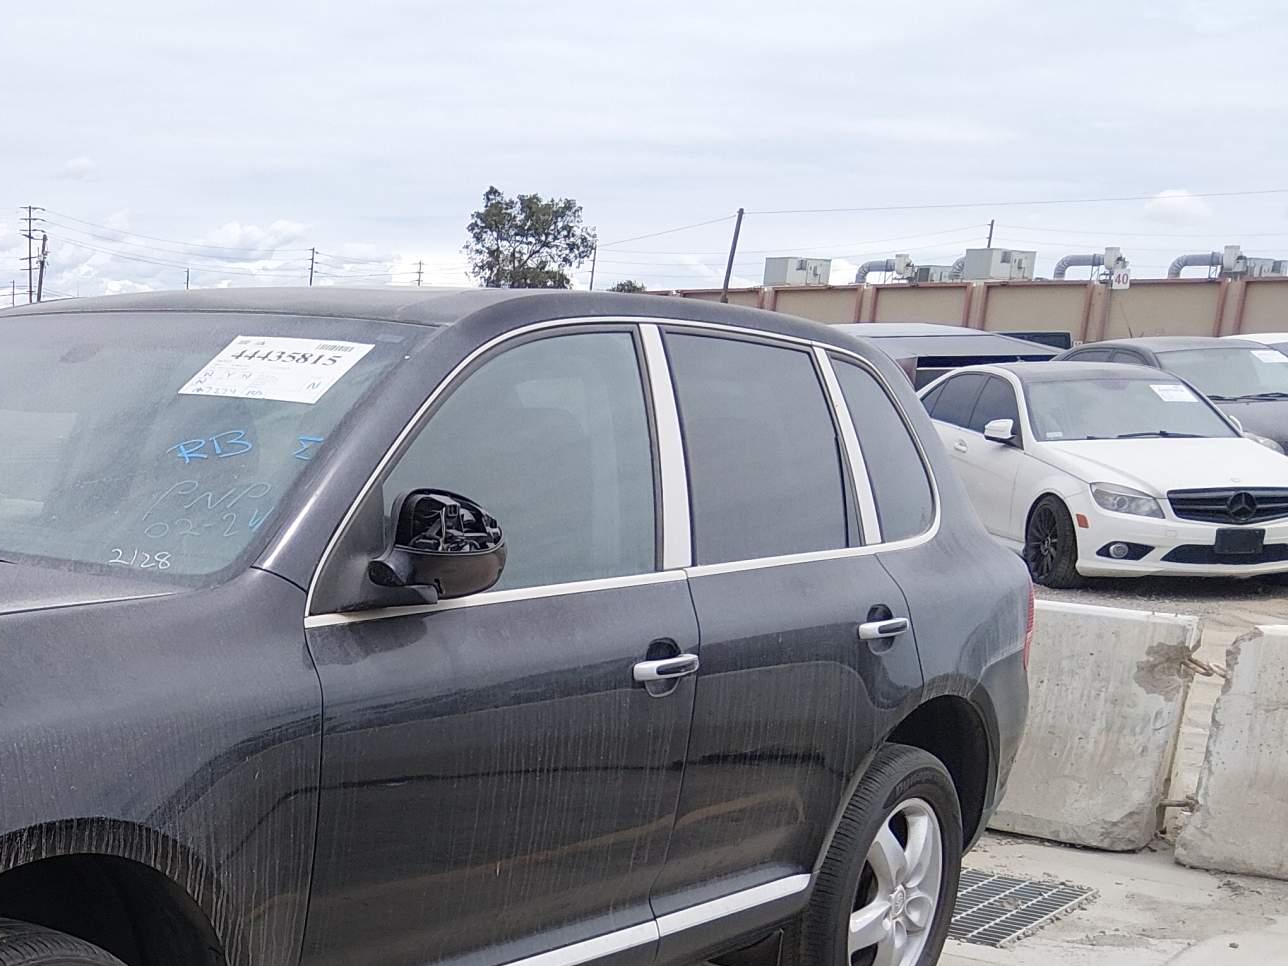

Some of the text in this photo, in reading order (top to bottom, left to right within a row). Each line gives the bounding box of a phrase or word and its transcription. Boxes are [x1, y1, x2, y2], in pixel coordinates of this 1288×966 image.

[1114, 273, 1128, 285] 40
[231, 349, 342, 366] 44435815
[166, 430, 253, 464] RB
